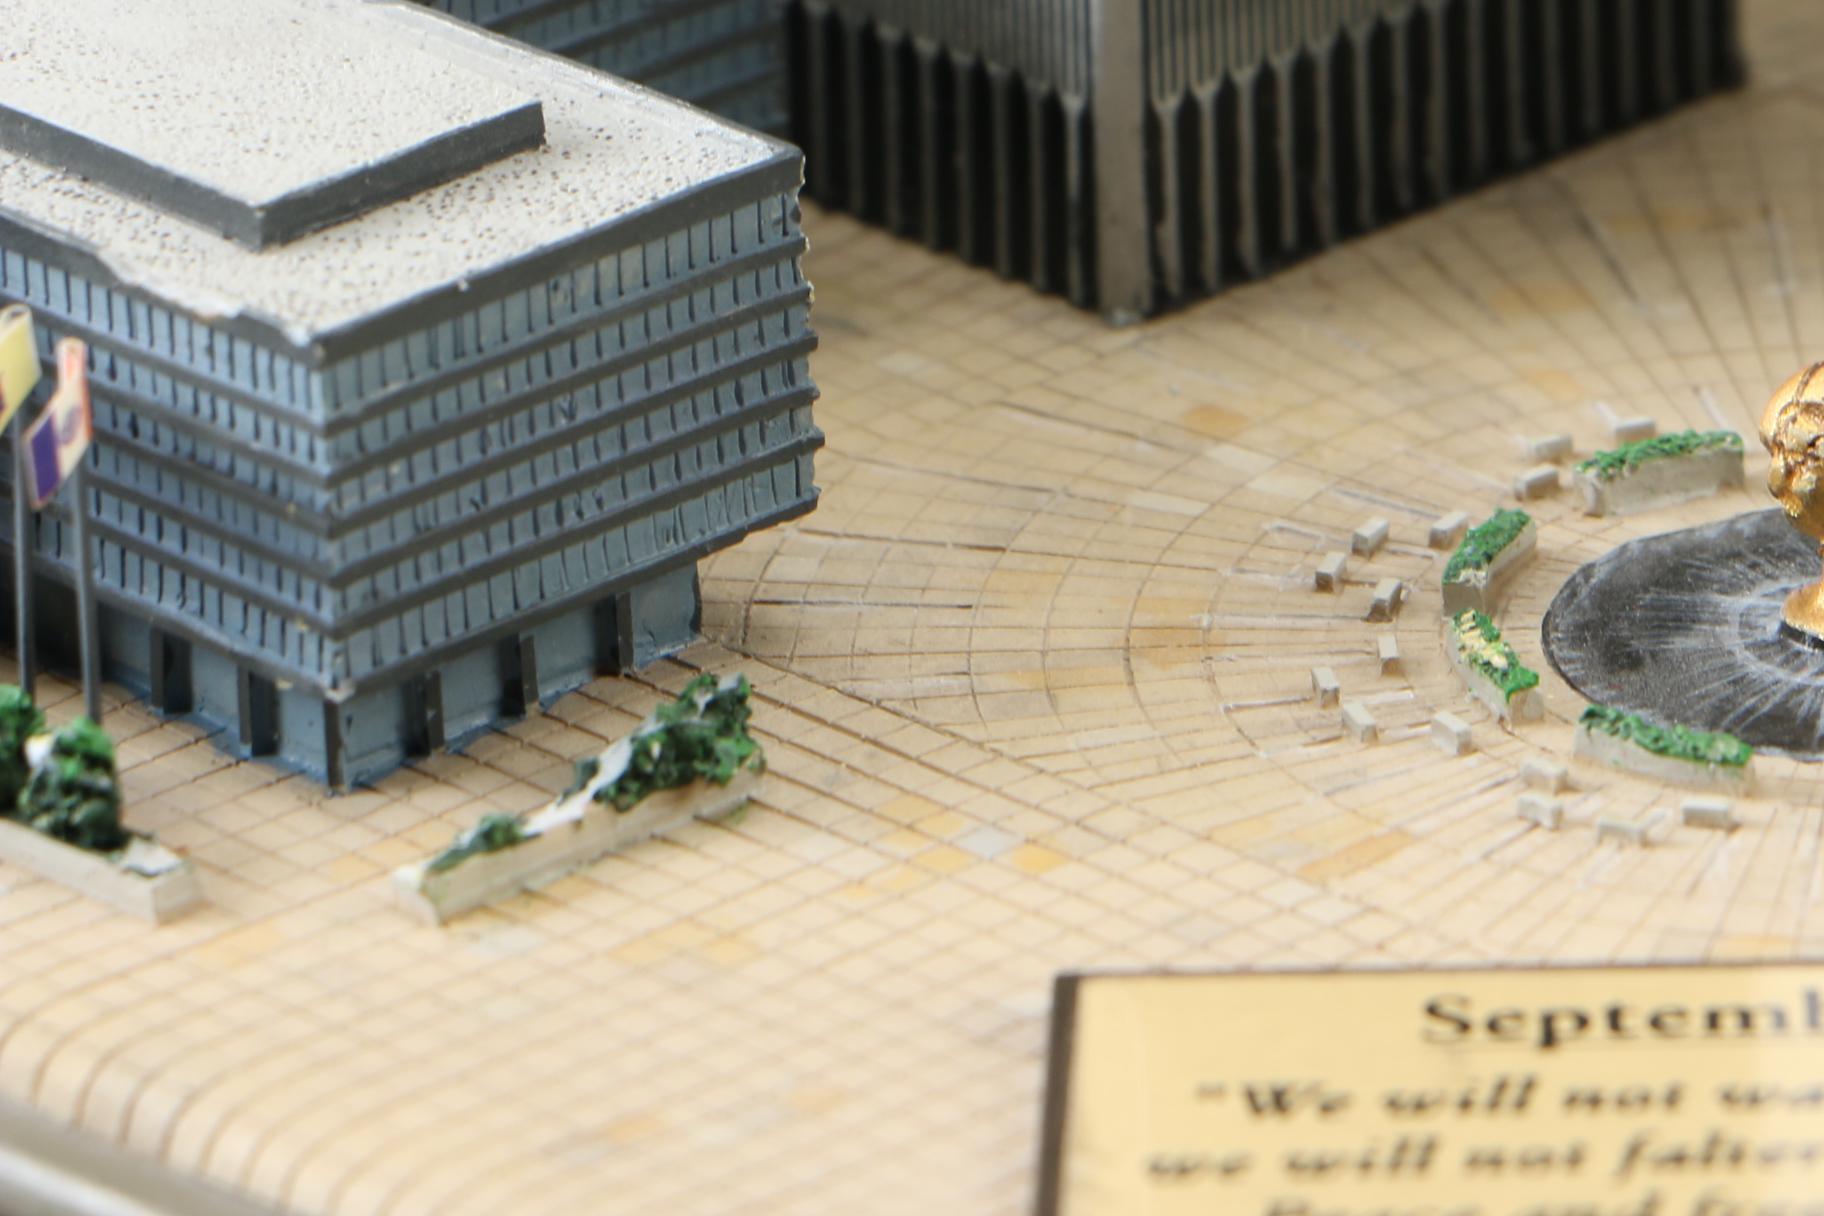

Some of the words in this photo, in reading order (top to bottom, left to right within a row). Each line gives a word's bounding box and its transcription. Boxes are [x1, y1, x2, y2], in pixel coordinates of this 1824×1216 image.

[1382, 1072, 1540, 1116] will
[1562, 1080, 1686, 1110] not
[1148, 1152, 1256, 1180] we
[1284, 1132, 1440, 1178] will
[1464, 1140, 1588, 1172] not
